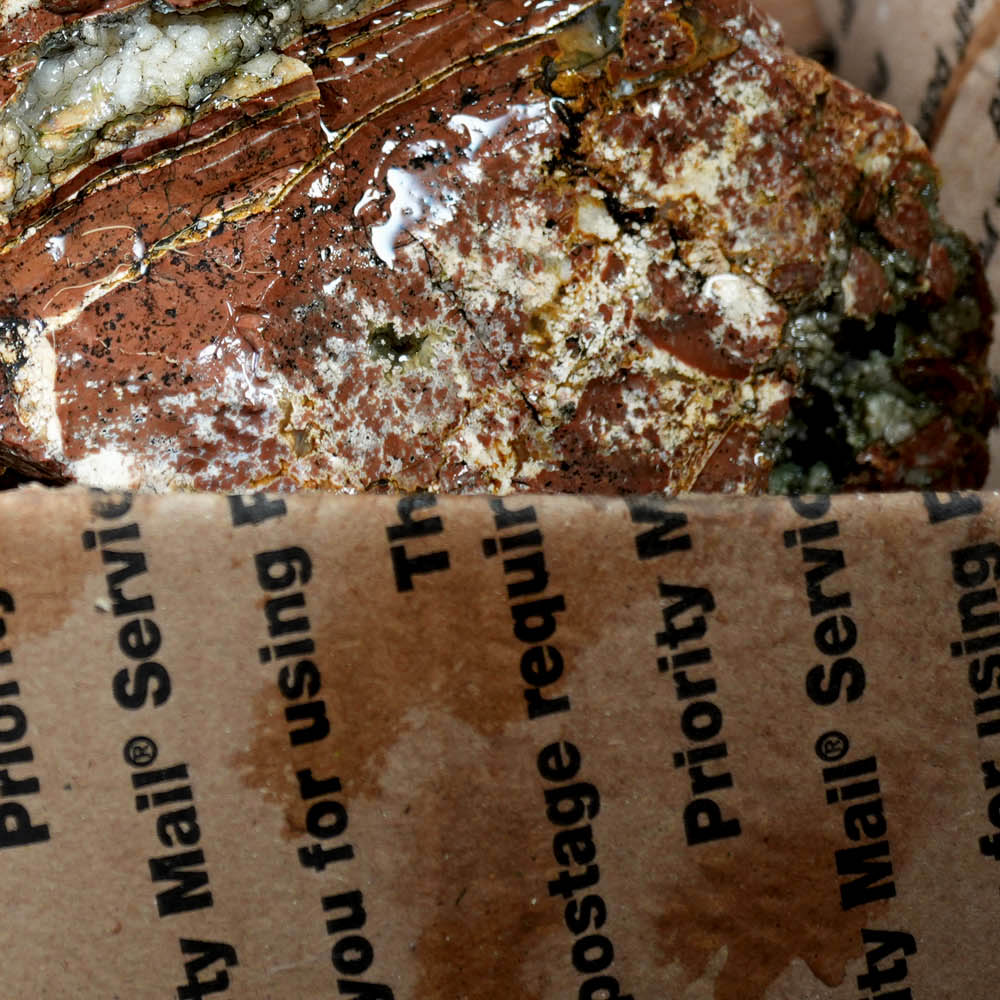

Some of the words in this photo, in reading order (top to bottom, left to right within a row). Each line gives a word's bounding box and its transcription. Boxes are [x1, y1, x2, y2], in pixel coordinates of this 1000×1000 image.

[256, 546, 326, 751] using
[656, 576, 743, 847] Priority
[124, 736, 213, 917] Mail®
[292, 767, 354, 871] for
[811, 731, 896, 915] Mail®
